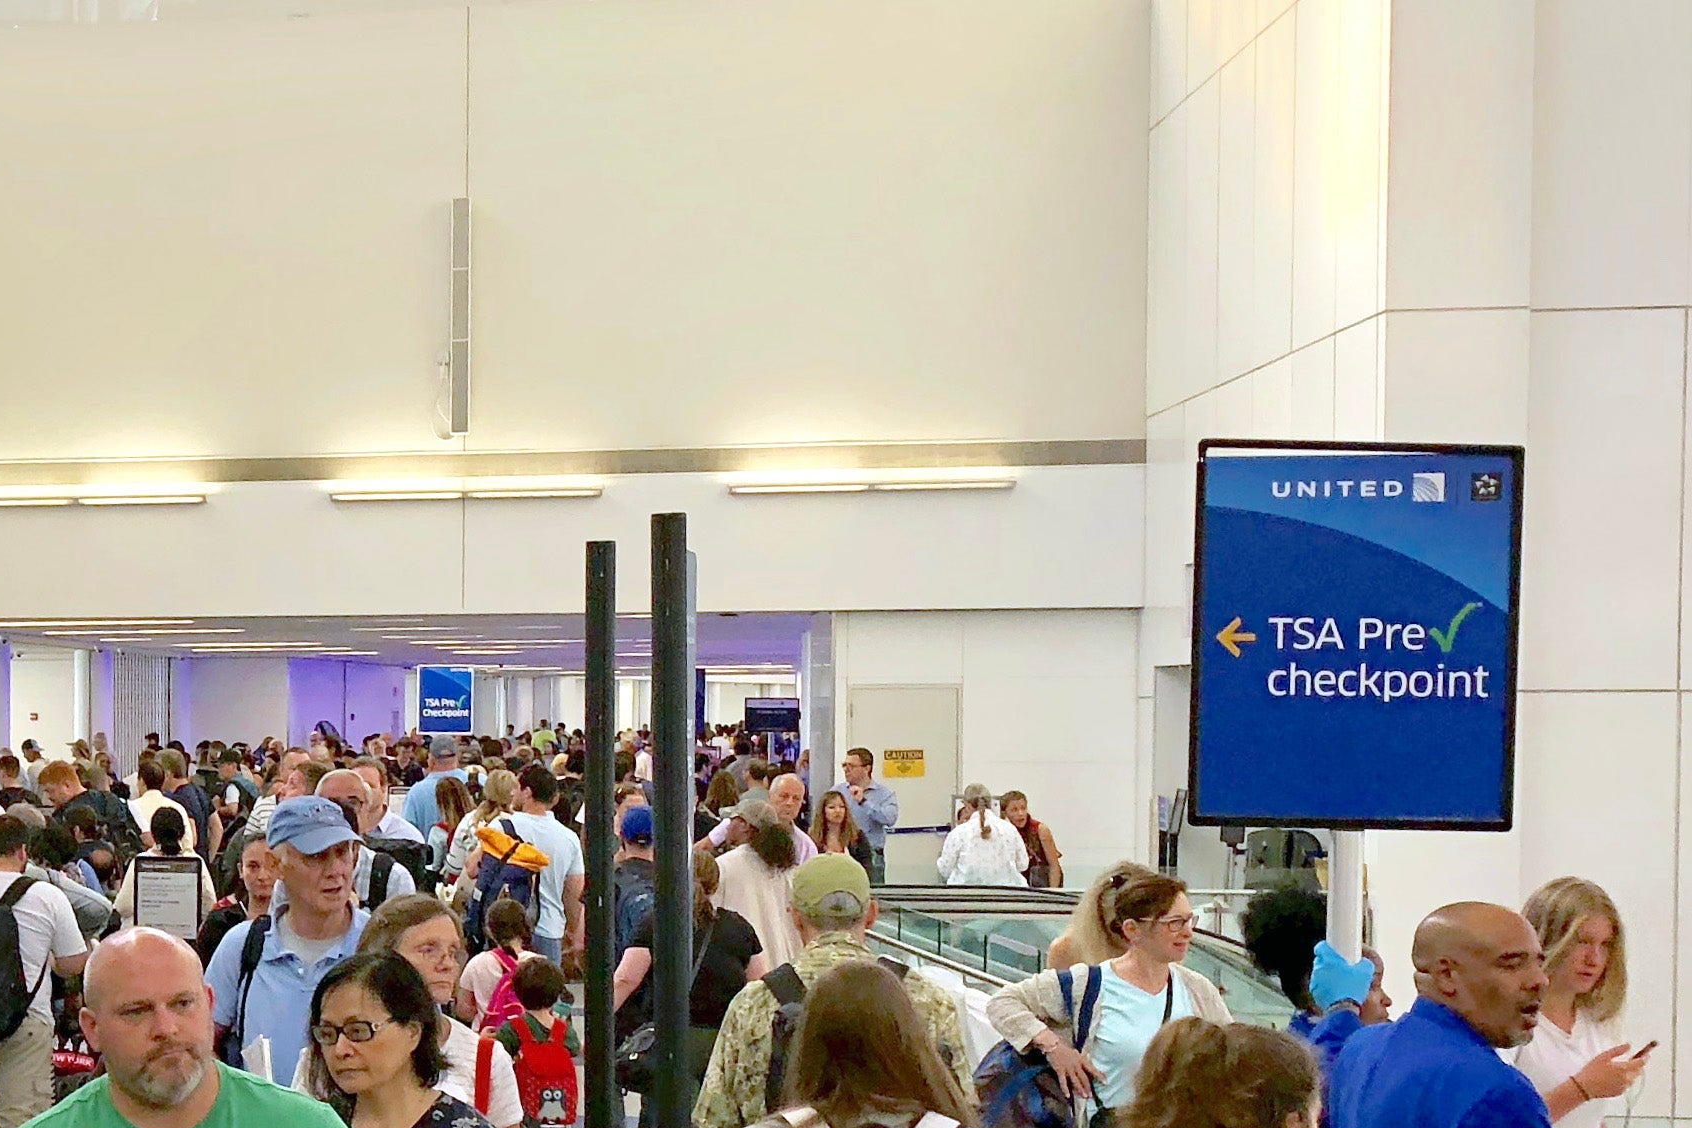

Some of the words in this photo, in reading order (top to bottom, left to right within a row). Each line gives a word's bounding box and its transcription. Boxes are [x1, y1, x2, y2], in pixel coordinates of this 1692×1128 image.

[1271, 480, 1404, 498] UNITED
[1268, 617, 1345, 650] TSA
[1359, 617, 1425, 650] Pre
[1267, 662, 1490, 703] checkpoint
[425, 698, 440, 707] TSA
[441, 698, 455, 707] Pre
[885, 751, 923, 760] CAUTION
